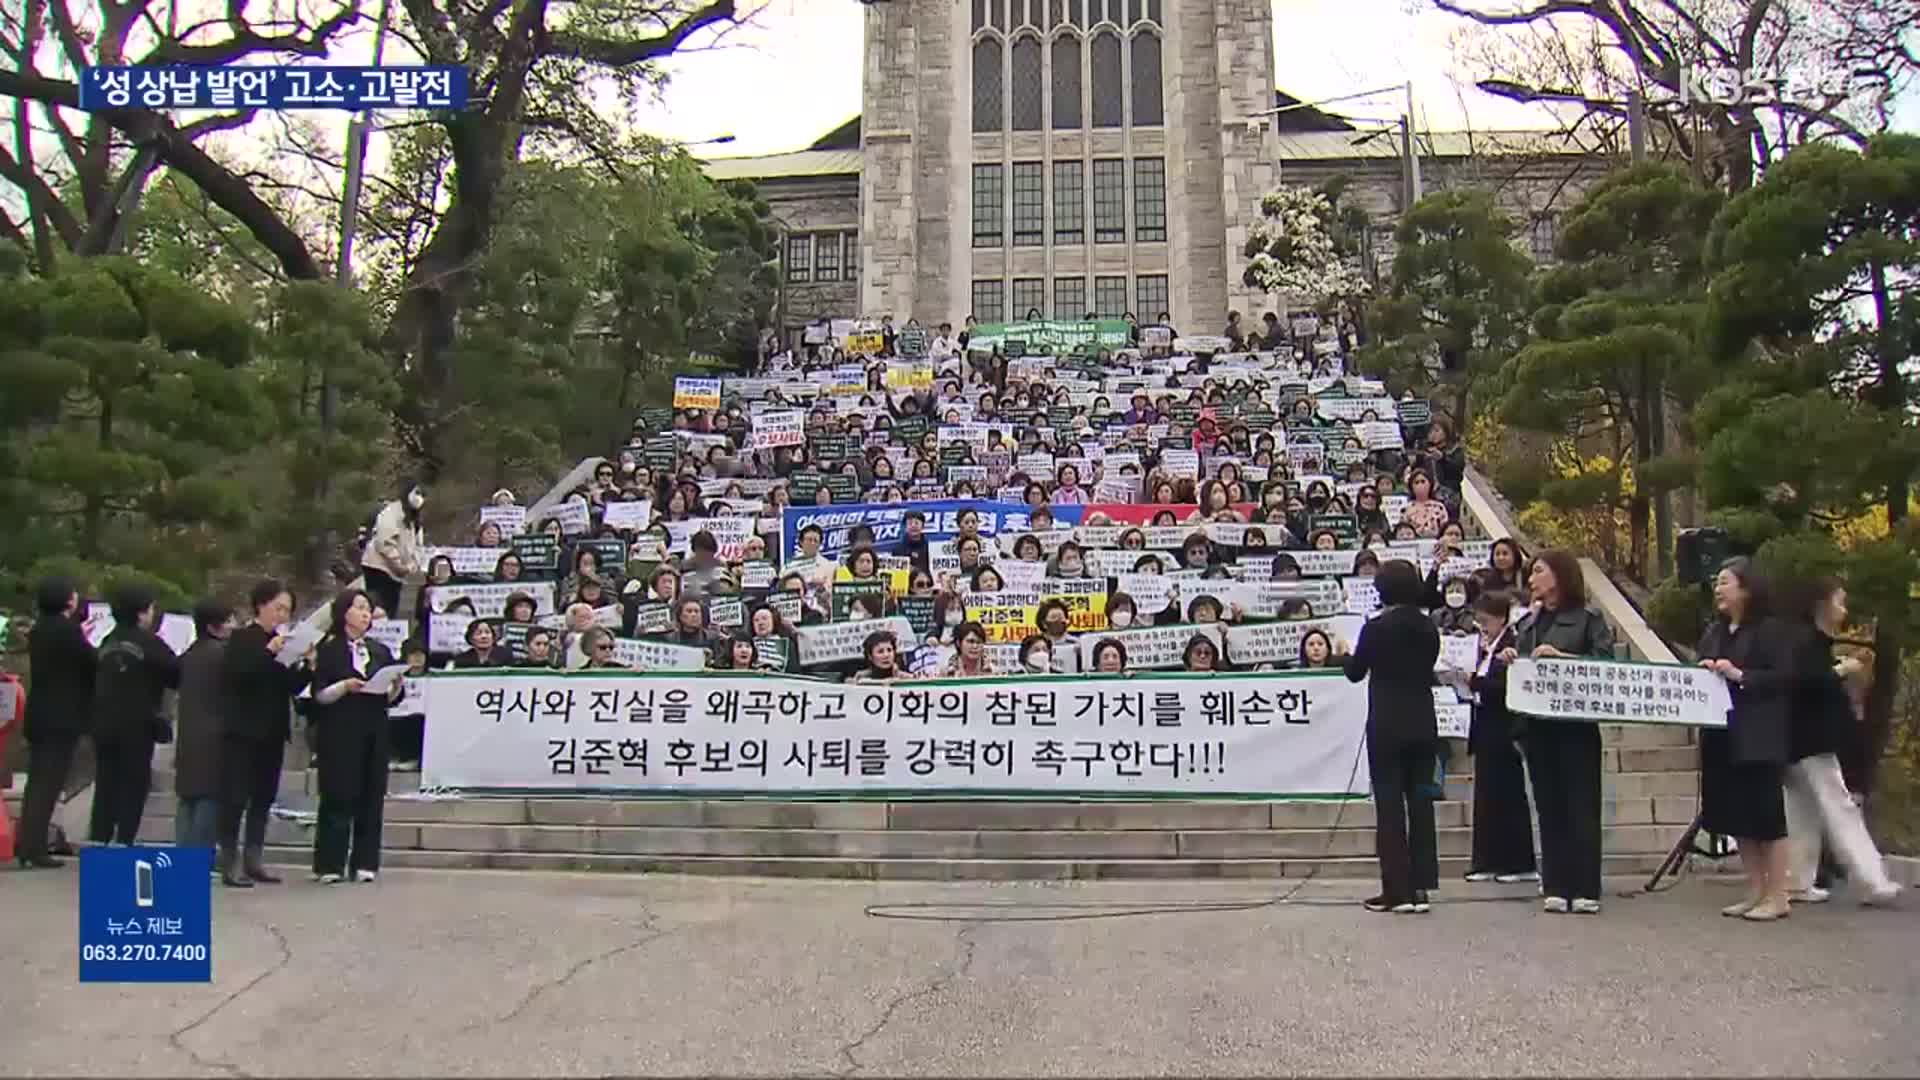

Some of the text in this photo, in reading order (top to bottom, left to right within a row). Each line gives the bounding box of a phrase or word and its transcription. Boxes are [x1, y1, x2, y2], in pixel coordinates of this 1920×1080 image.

[963, 594, 993, 607] 이화는
[980, 608, 1023, 624] 김준혁
[1536, 664, 1560, 678] 한국
[1564, 665, 1600, 679] 사회의
[1606, 667, 1652, 681] 공동선과
[1578, 683, 1614, 697] 이화의
[1619, 686, 1653, 700] 역사를
[476, 688, 1312, 728] 역사와 진실을 왜곡하고 이화의 참된 가치를 훼손한
[1550, 699, 1680, 717] 김준혁 후보를 규탄한다
[547, 738, 1226, 778] 김준혁 후보의 사퇴를 강력히 촉구한다!!!
